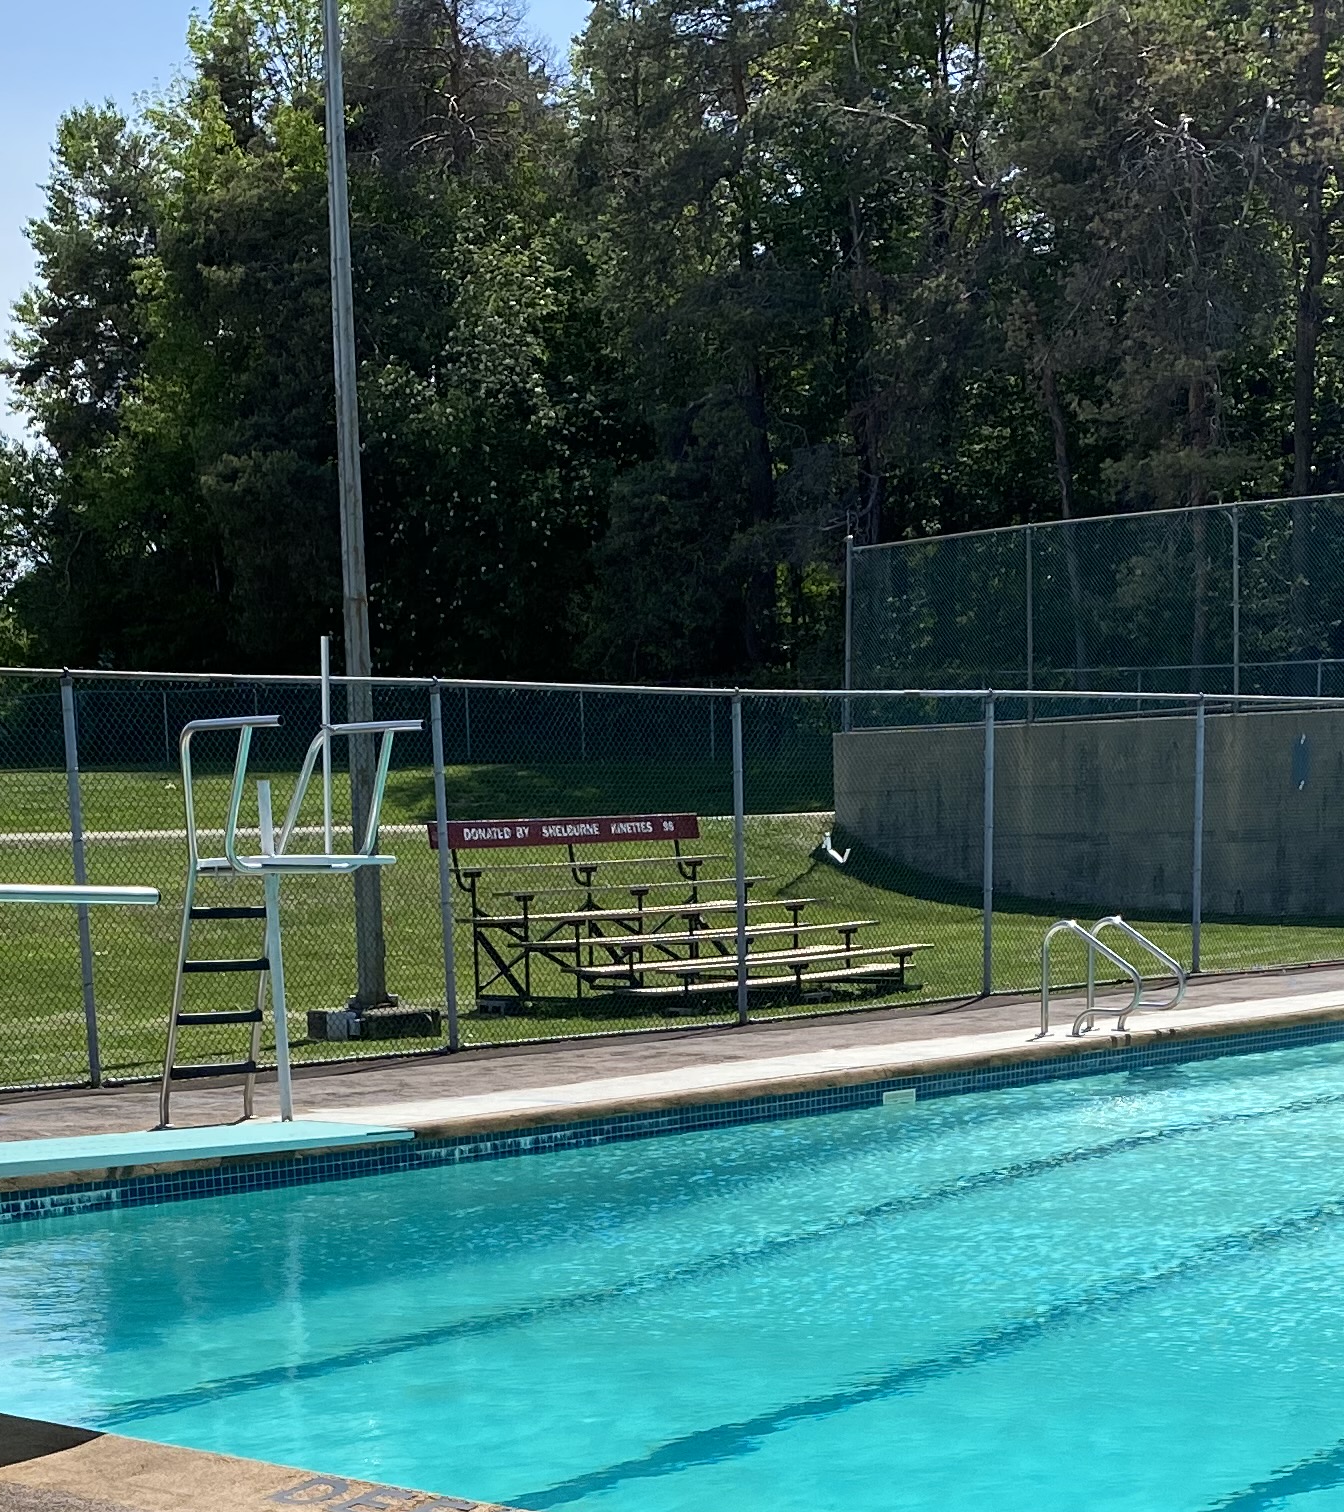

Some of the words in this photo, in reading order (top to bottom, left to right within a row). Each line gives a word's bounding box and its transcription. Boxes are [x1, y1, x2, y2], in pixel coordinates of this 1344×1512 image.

[463, 826, 511, 841] DONATED
[516, 826, 530, 839] BY
[541, 823, 600, 837] SHELBURNE
[610, 821, 654, 834] KINETTES
